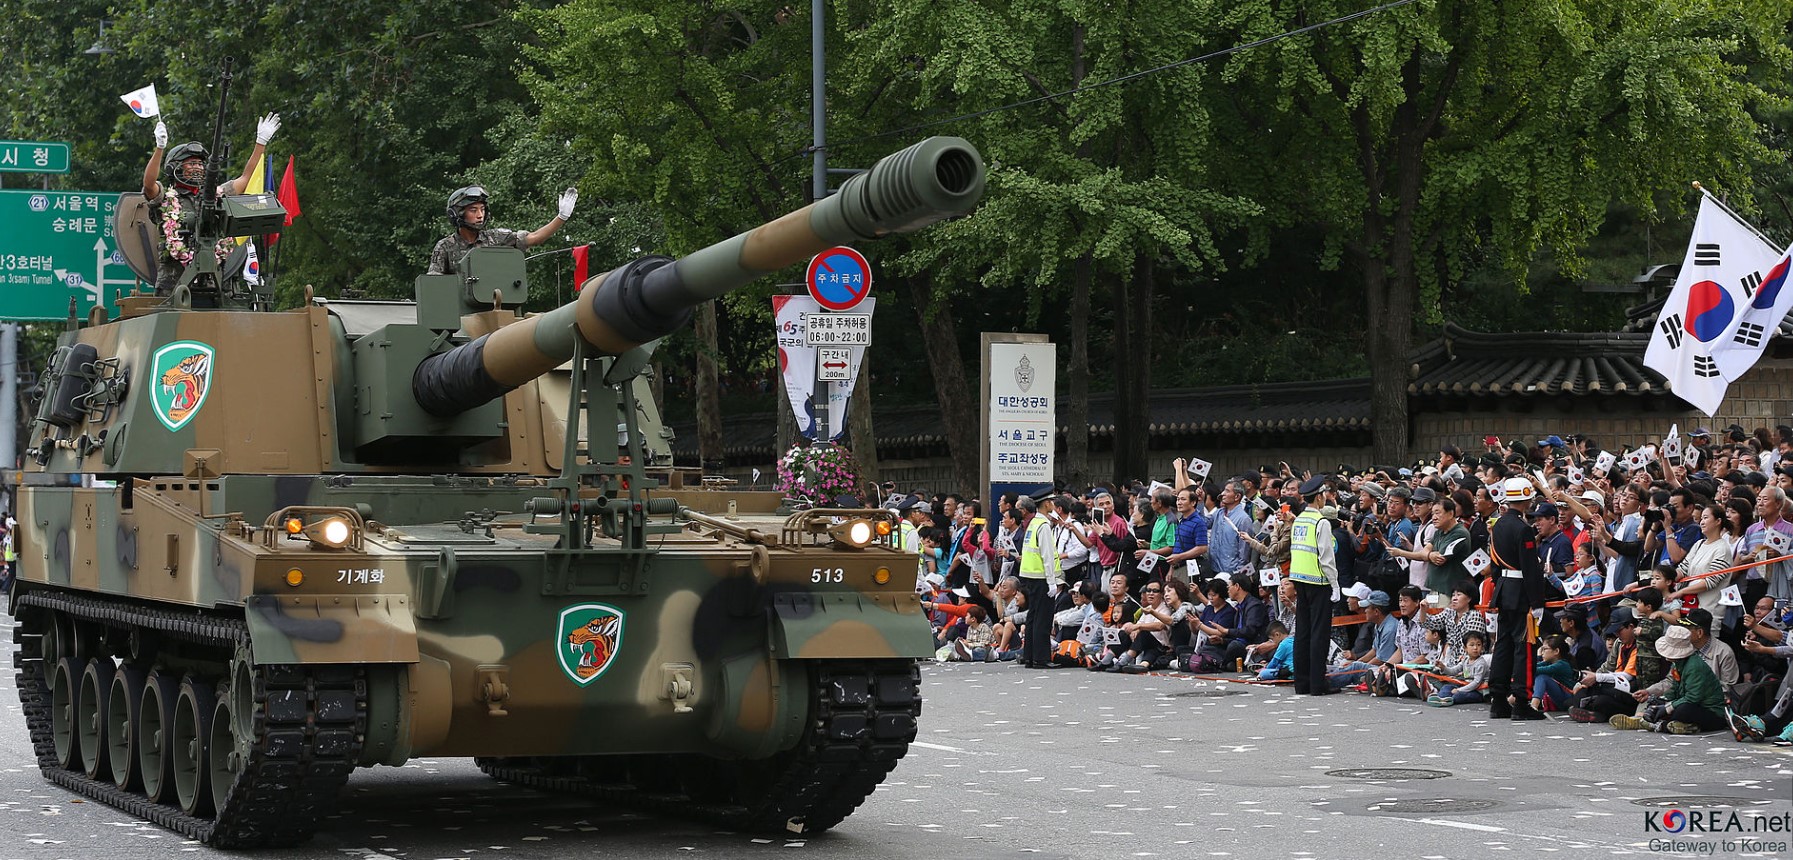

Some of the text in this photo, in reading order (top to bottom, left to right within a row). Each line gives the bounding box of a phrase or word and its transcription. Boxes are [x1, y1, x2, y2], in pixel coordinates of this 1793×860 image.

[34, 199, 45, 208] 21
[53, 196, 98, 211] 서울역
[52, 217, 98, 233] 숭례문
[32, 274, 53, 285] Tunnel
[69, 275, 80, 285] 31
[817, 273, 861, 284] 주차금지
[809, 317, 867, 329] 공휴일 주차허용
[809, 331, 867, 342] 06:00~22:00
[998, 396, 1048, 408] 대한성공회
[998, 453, 1048, 464] 주교좌성당
[337, 568, 385, 584] 기계화
[811, 568, 844, 583] 513
